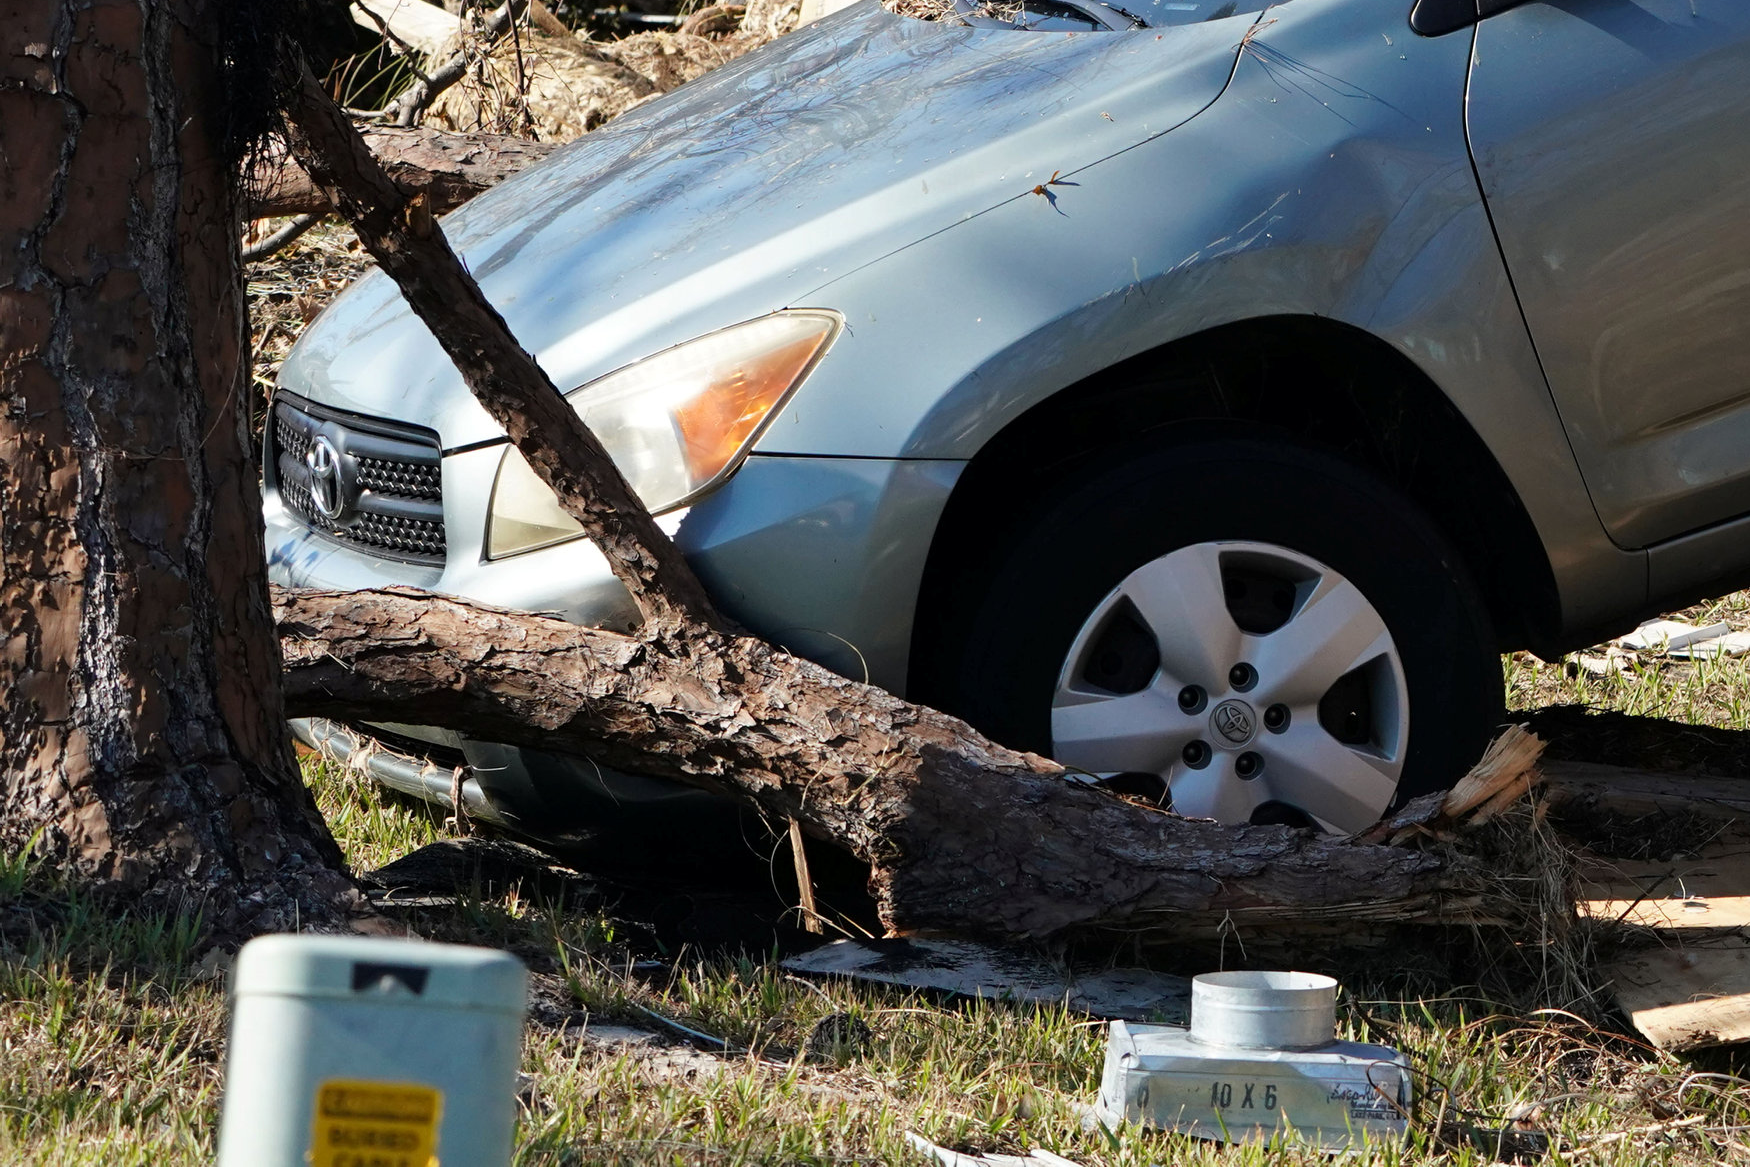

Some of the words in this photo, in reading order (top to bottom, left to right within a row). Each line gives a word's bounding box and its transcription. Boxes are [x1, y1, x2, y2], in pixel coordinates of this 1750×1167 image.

[1211, 1082, 1232, 1109] 10
[1241, 1083, 1254, 1109] X
[1264, 1084, 1277, 1111] 6
